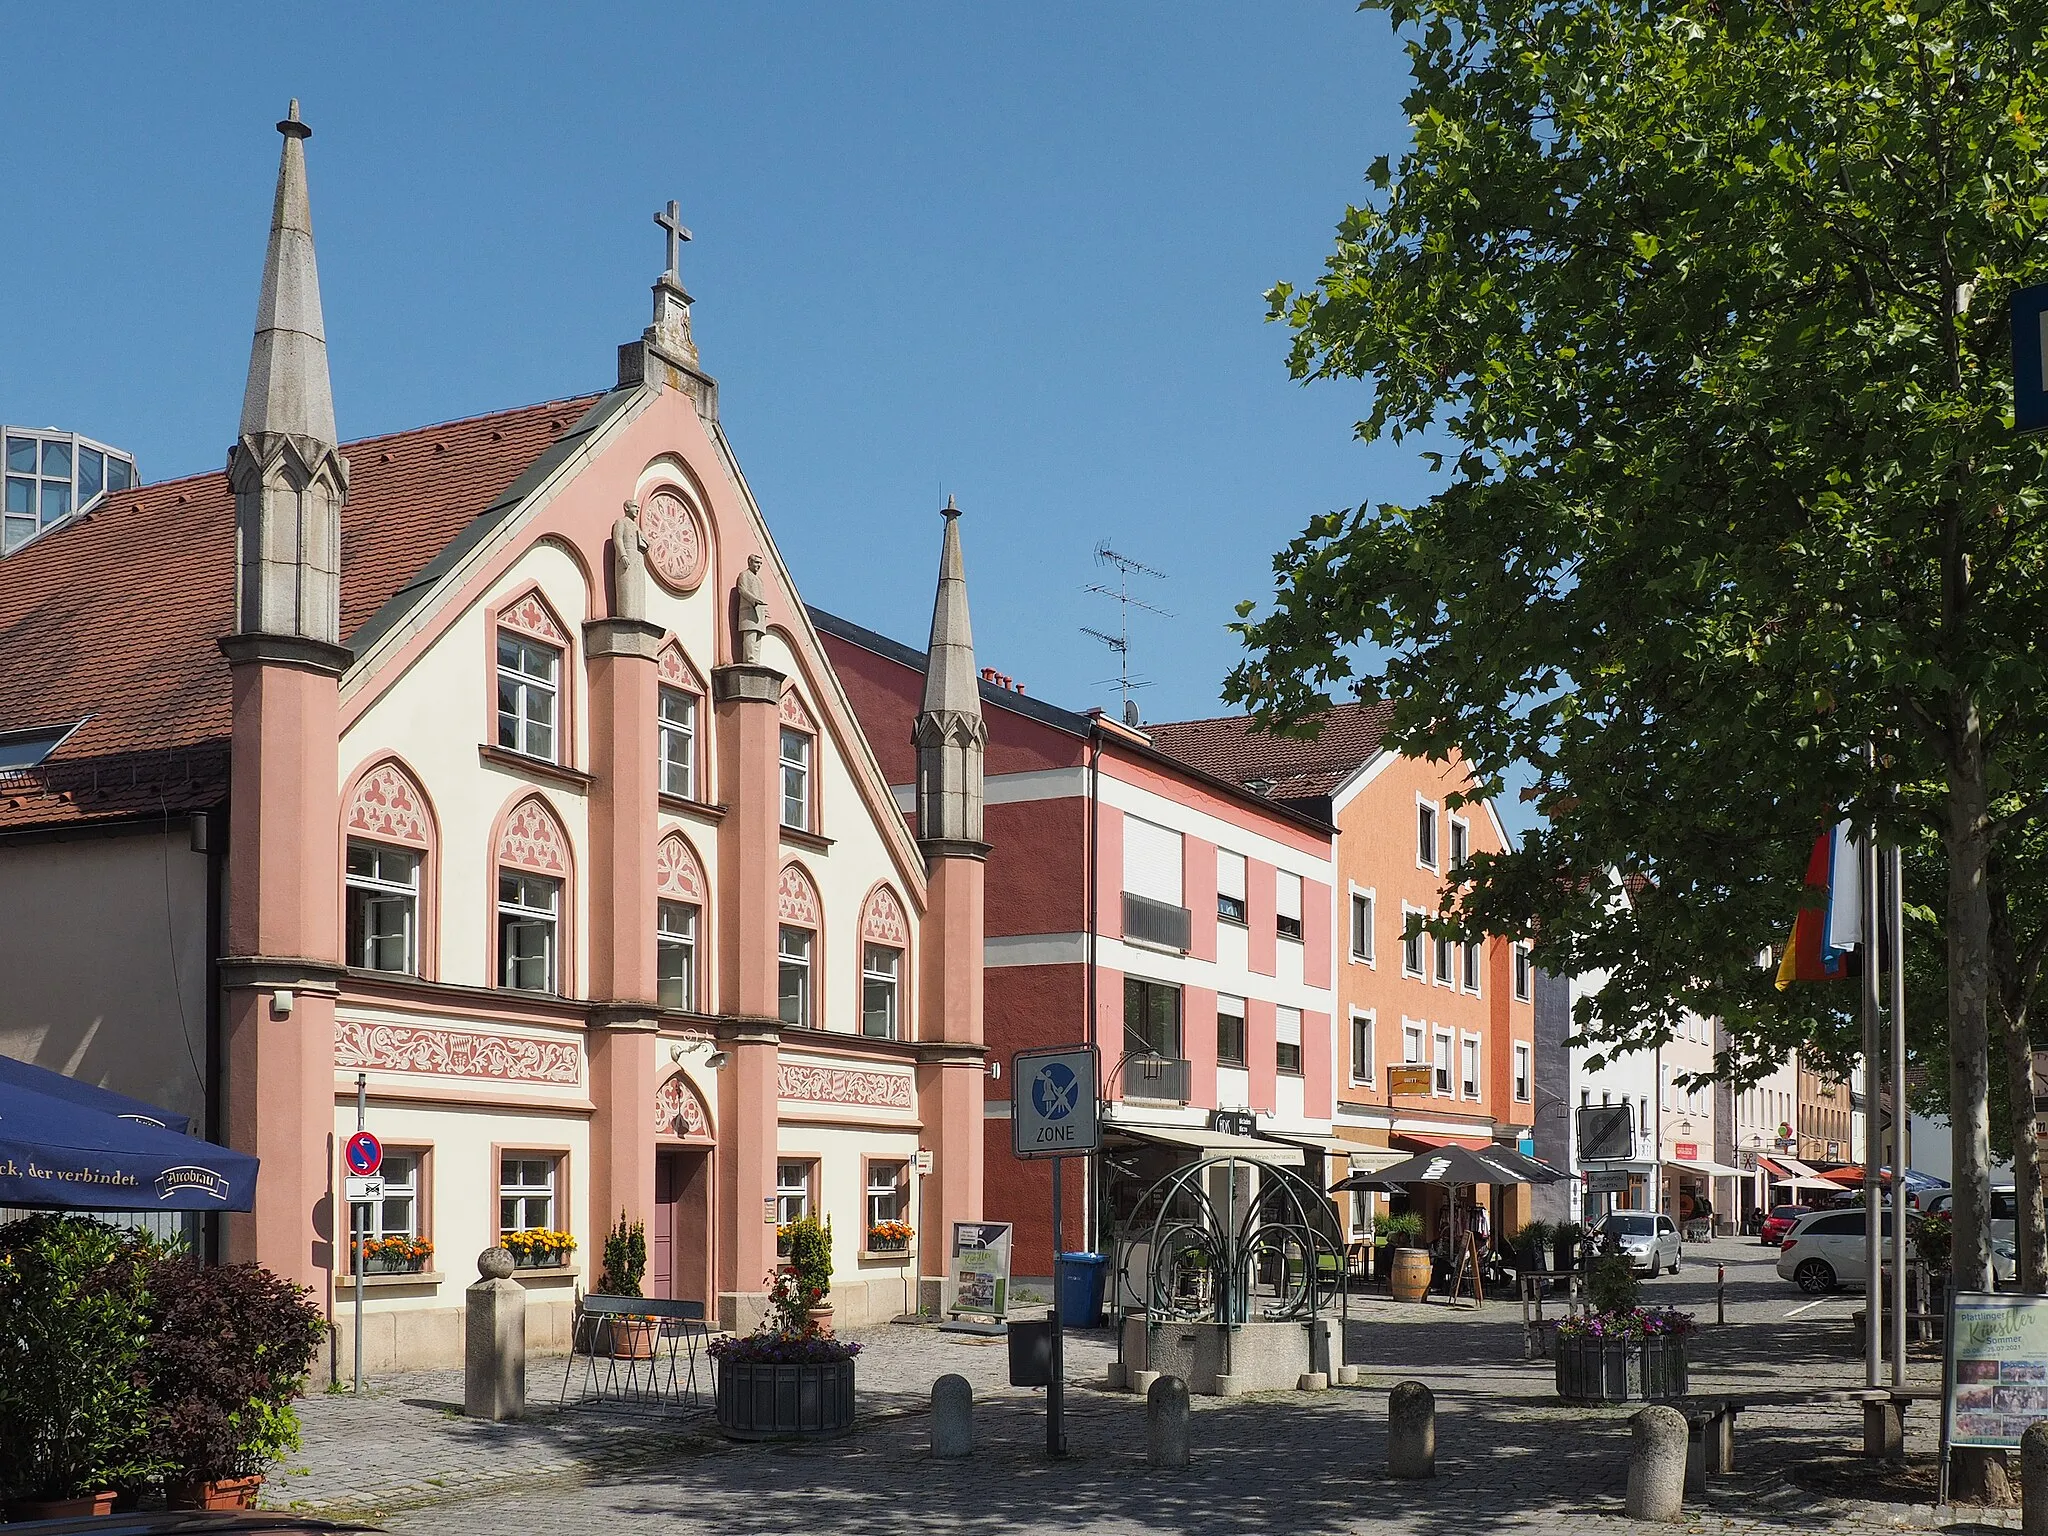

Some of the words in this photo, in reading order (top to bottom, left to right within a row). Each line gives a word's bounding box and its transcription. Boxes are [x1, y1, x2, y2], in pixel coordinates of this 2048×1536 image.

[1036, 1125, 1075, 1142] ZONE
[28, 1162, 53, 1179] der
[57, 1167, 140, 1186] verbindet.
[1961, 1312, 2006, 1322] Plattlinger
[1986, 1335, 2022, 1345] Sommer
